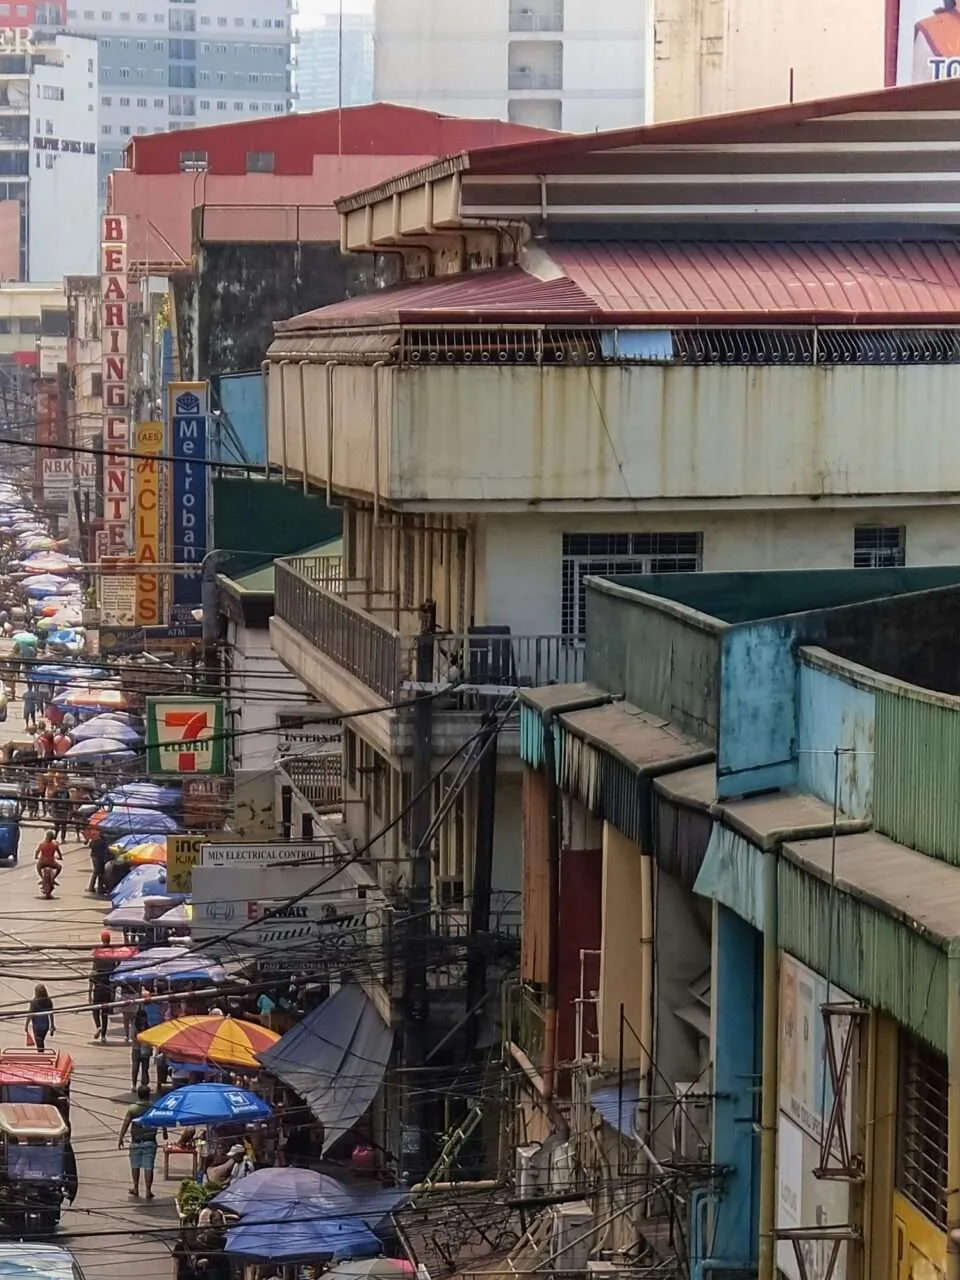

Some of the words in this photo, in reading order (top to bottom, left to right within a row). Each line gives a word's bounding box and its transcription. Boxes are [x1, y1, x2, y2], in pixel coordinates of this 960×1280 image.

[104, 218, 126, 406] BEARING
[106, 418, 126, 557] CENTE
[165, 712, 208, 771] 7
[226, 850, 278, 860] ELECTRICAL
[279, 850, 317, 860] CONTROL
